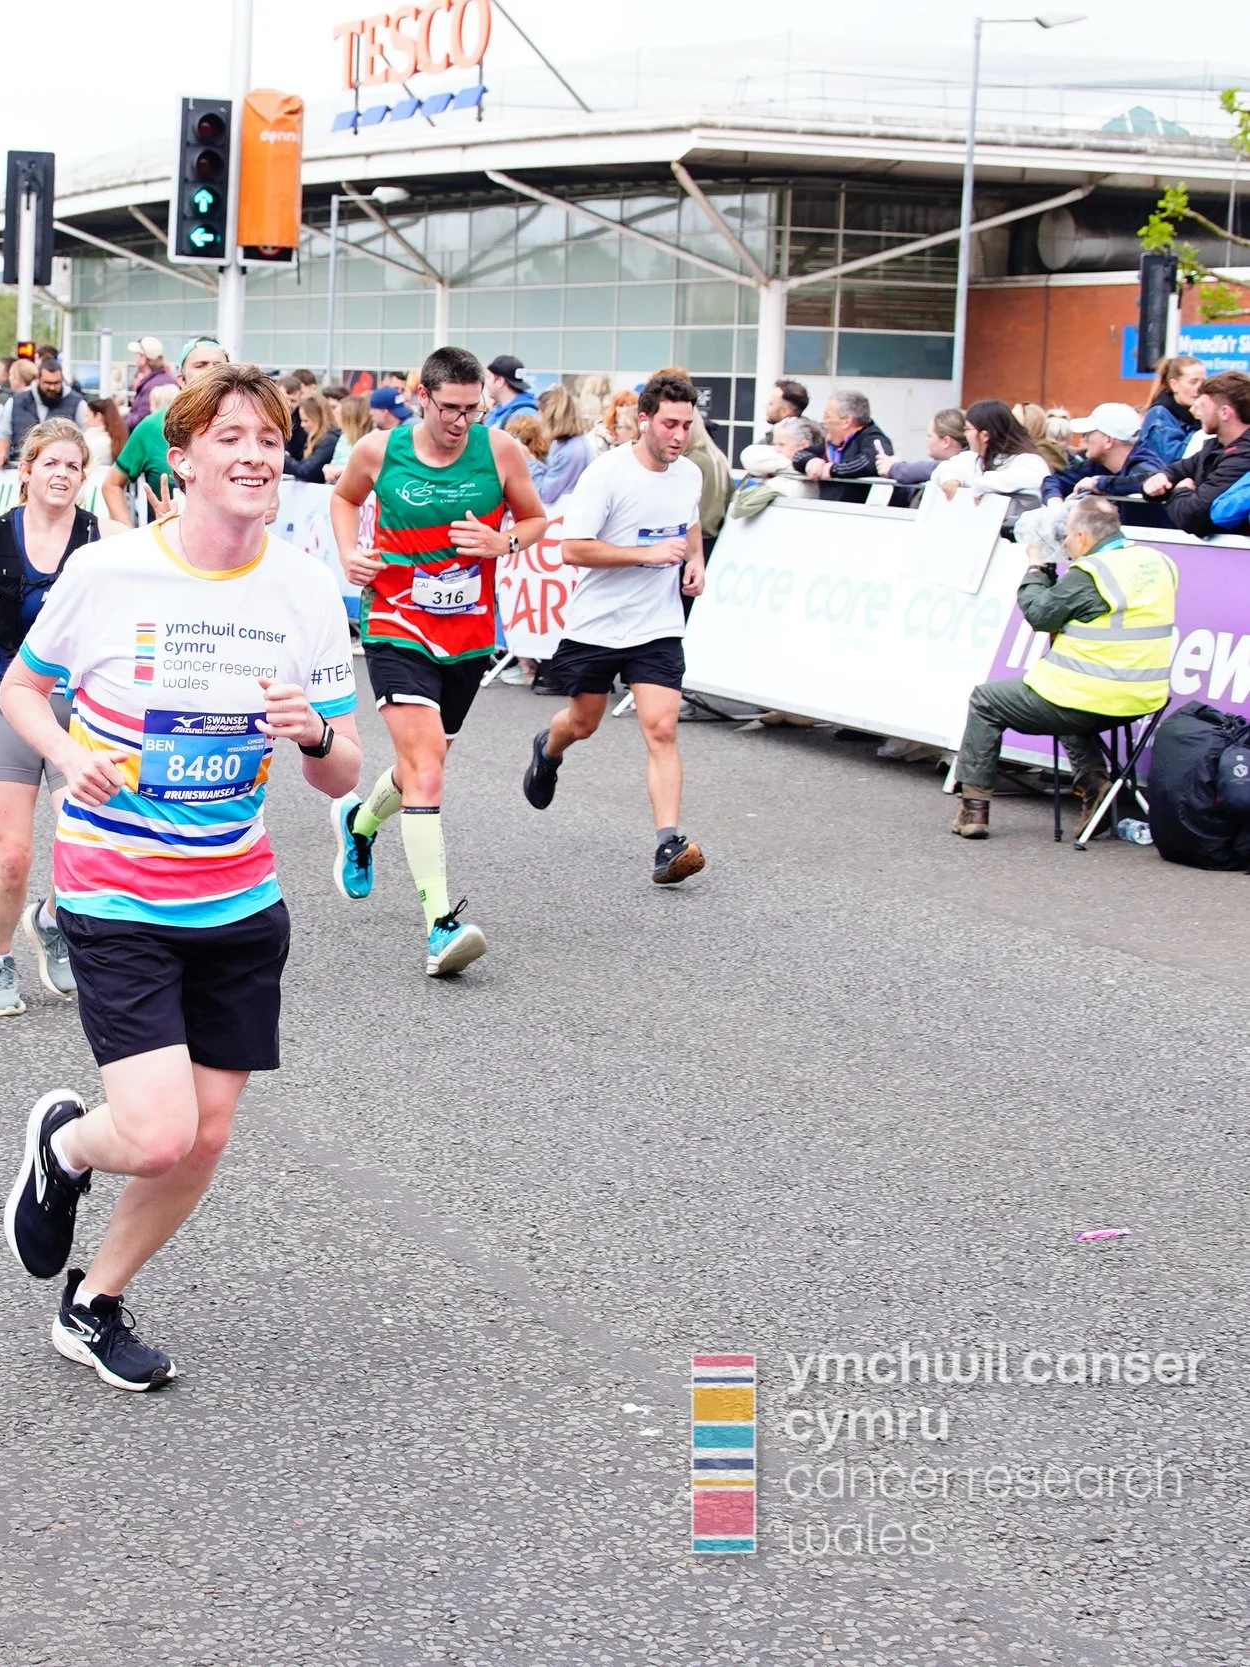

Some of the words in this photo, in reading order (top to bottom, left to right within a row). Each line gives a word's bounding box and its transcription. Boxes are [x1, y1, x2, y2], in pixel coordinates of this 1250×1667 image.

[333, 0, 491, 91] TESCO
[432, 591, 463, 604] 316
[714, 561, 794, 613] core
[805, 574, 892, 630] core
[904, 588, 1002, 649] core
[165, 621, 235, 638] ymchwil
[239, 626, 286, 644] canser
[164, 641, 216, 656] cymru
[163, 659, 217, 673] cancer
[311, 663, 353, 685] #TEA
[162, 676, 209, 691] wales
[206, 716, 248, 725] SWANSEA
[145, 739, 174, 752] BEN
[166, 754, 241, 782] 8480
[164, 787, 235, 800] #RUNSWANSEA
